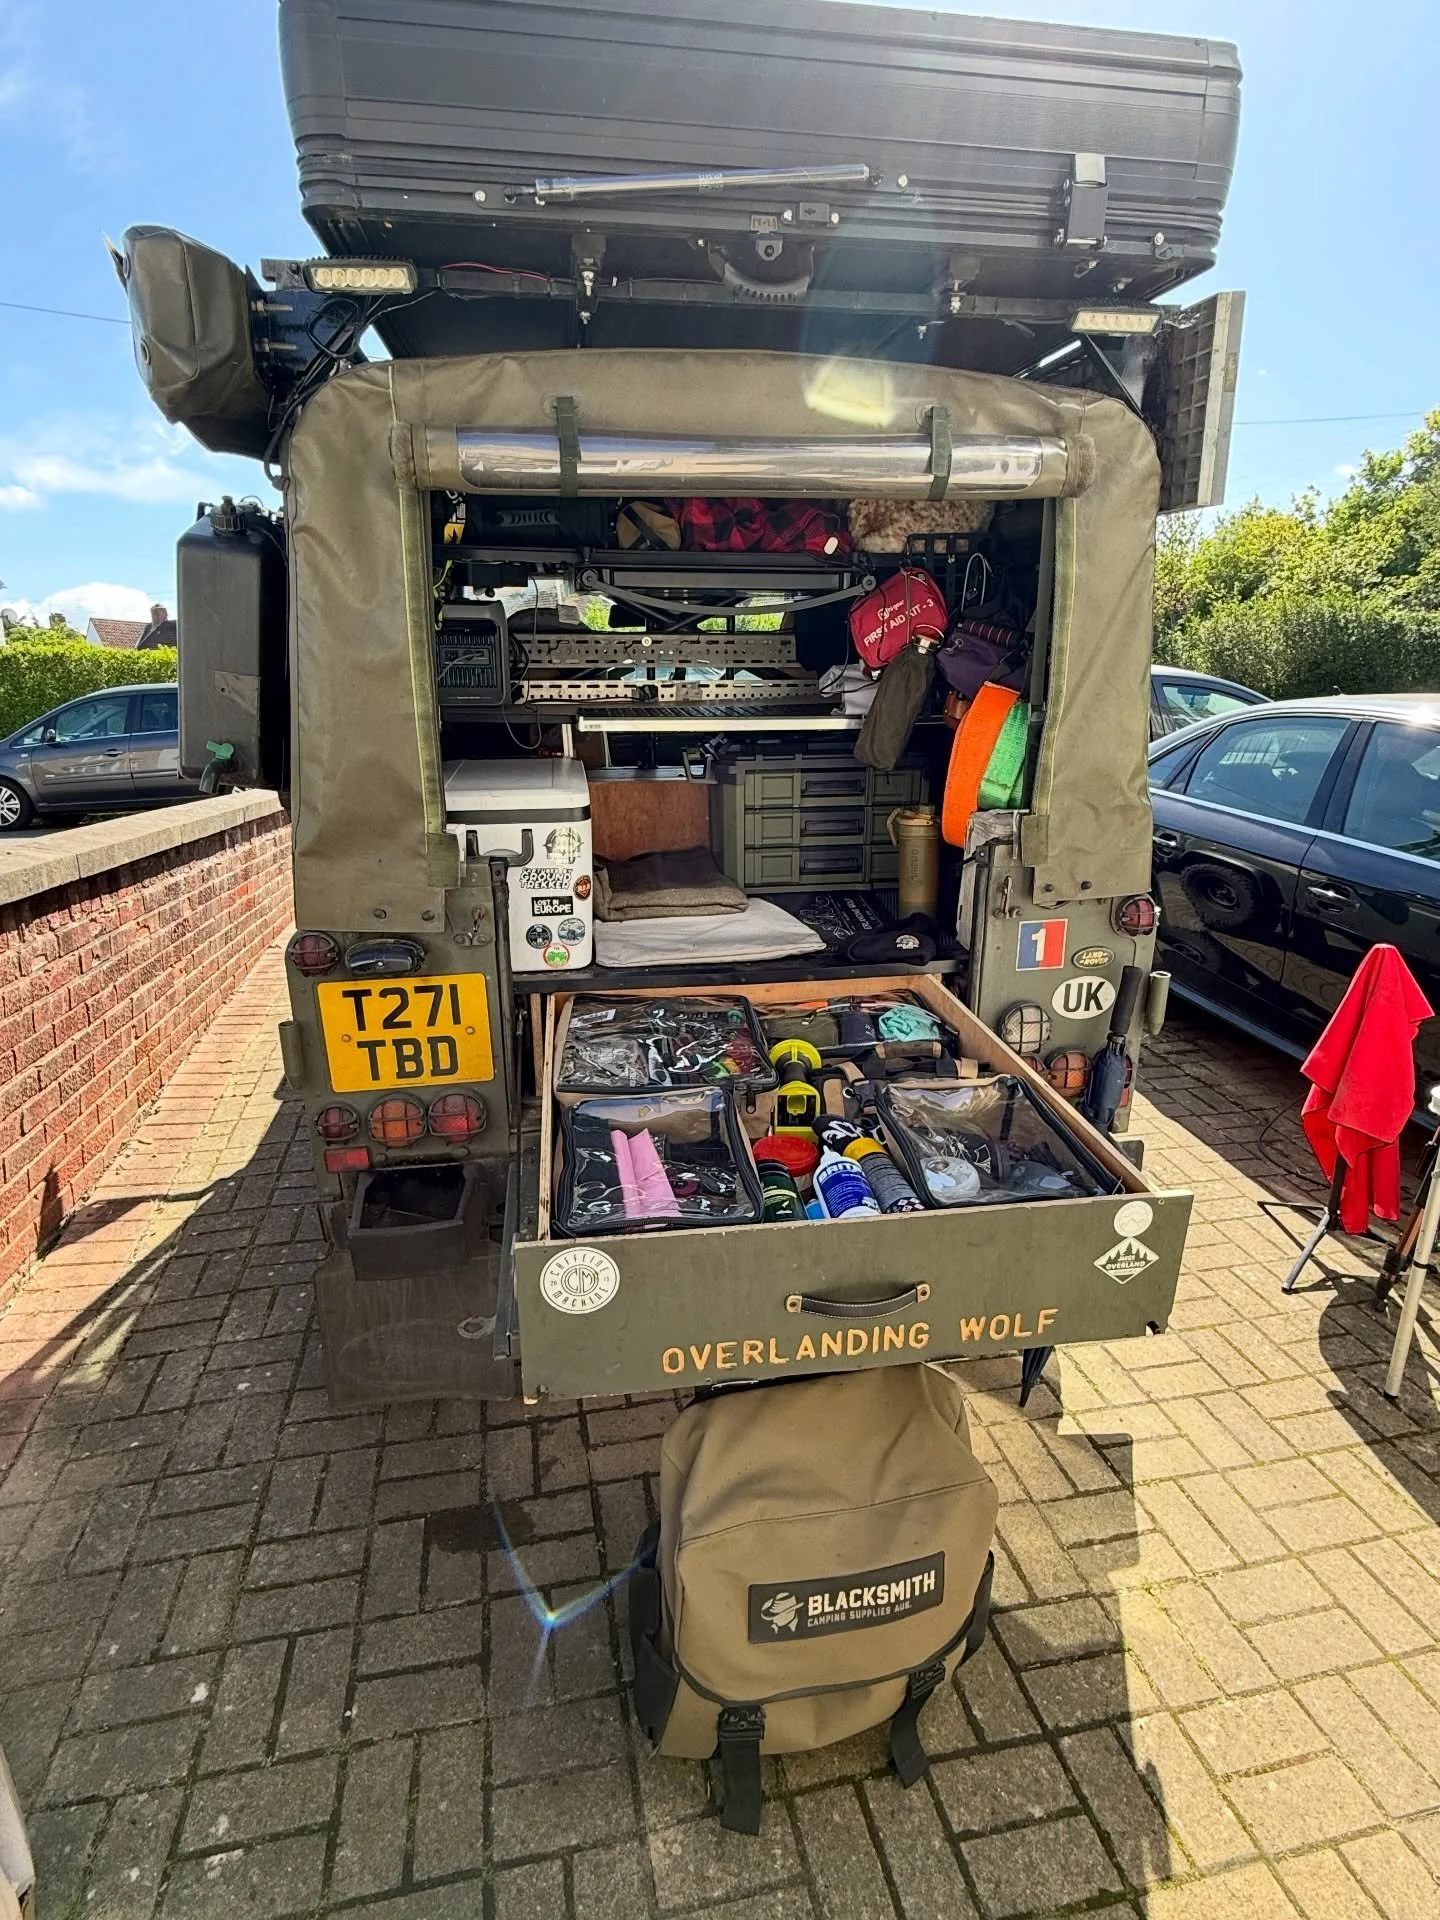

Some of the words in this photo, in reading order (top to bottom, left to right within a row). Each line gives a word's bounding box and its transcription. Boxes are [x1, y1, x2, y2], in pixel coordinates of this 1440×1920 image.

[863, 624, 888, 647] FIRST
[889, 614, 906, 630] AID
[926, 598, 934, 608] 3
[519, 880, 571, 890] TREKKER
[520, 872, 572, 883] GROUND
[534, 904, 572, 915] EUROPE
[1031, 928, 1047, 961] 1
[341, 983, 462, 1032] T271
[1063, 981, 1106, 1013] UK
[356, 1035, 459, 1081] TBD
[1105, 1260, 1146, 1270] OVERLAND
[661, 1322, 930, 1374] OVERLANDING
[959, 1308, 1060, 1342] WOLF
[807, 1569, 936, 1617] BLACKSMITH
[807, 1612, 846, 1627] CAMPING
[849, 1606, 891, 1620] SUPPLIES
